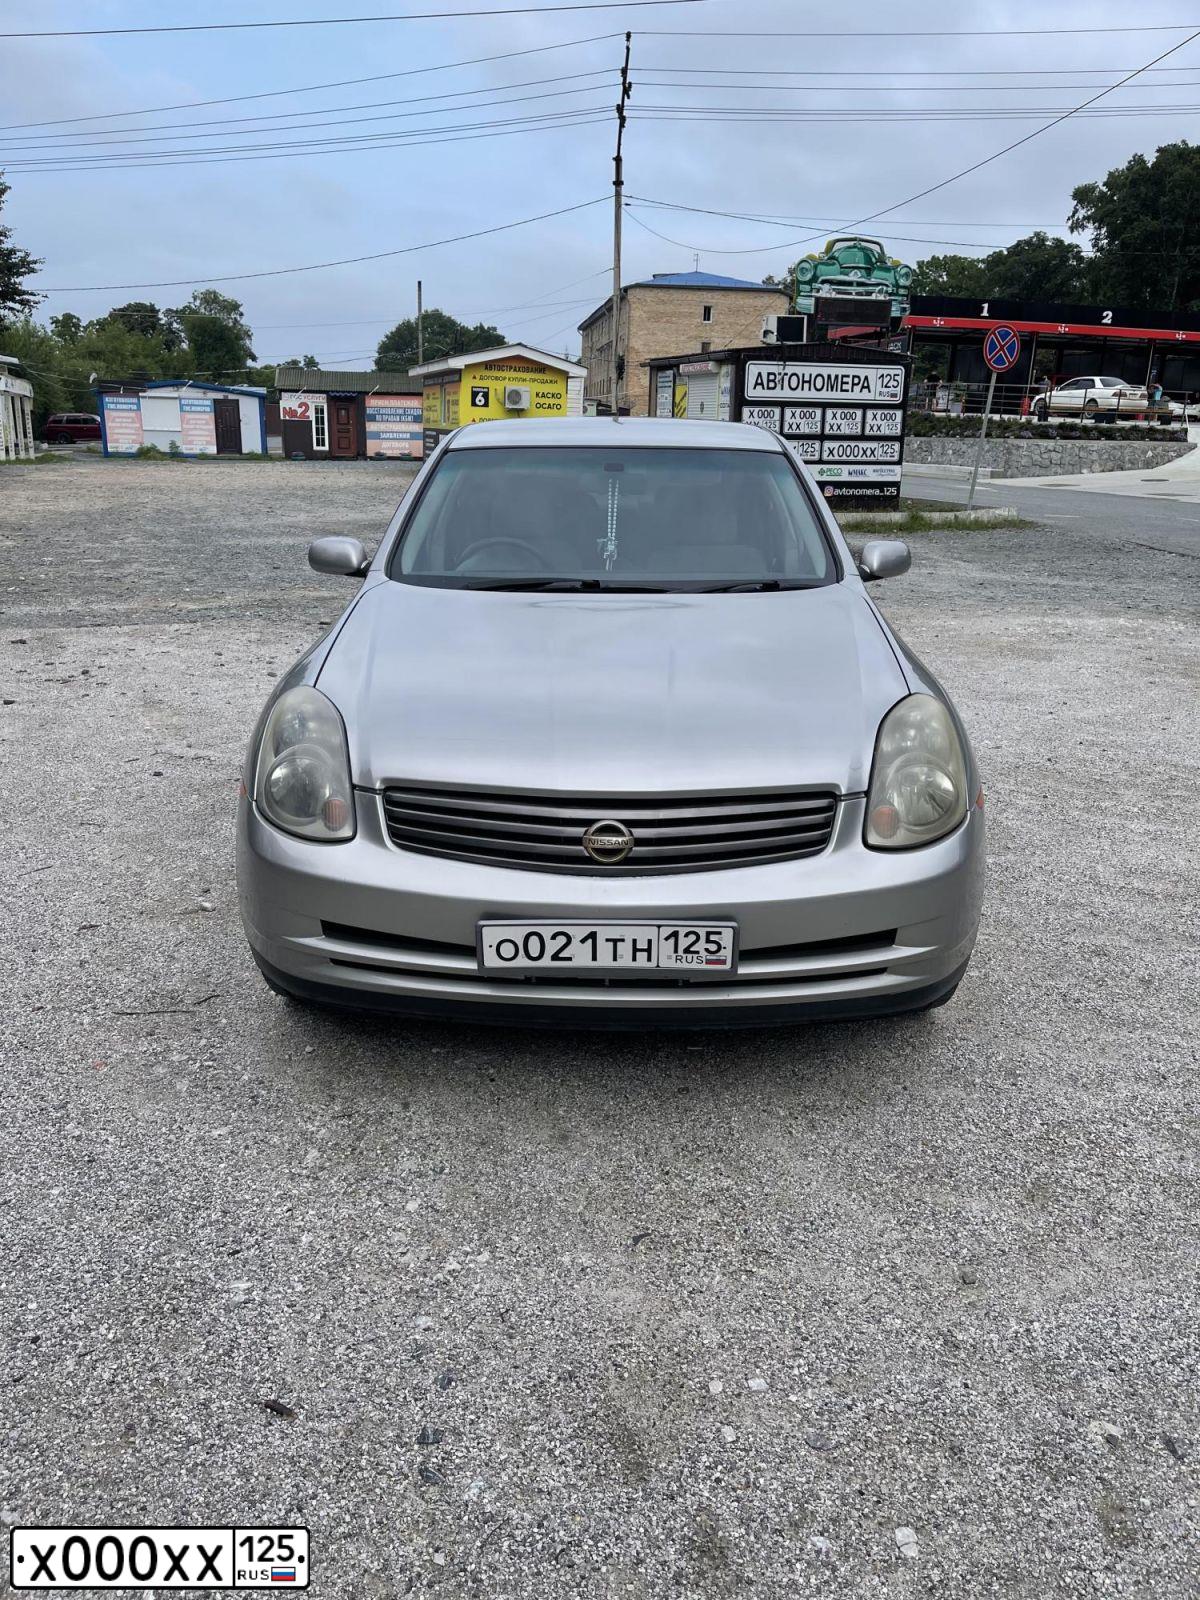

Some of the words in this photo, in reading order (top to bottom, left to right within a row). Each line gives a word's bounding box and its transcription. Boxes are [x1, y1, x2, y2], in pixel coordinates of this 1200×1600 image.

[980, 303, 989, 316] 1
[1101, 310, 1113, 324] 2
[484, 364, 546, 375] АВТОСТРАХОВАНИЕ
[753, 371, 872, 394] АВТОНОМЕРА
[878, 373, 900, 389] 125
[475, 392, 485, 406] 6
[535, 392, 562, 400] КАСКО
[535, 402, 562, 410] ОСАГО
[806, 422, 819, 430] 125
[847, 423, 859, 431] 125
[886, 423, 899, 431] 125
[799, 442, 816, 454] 125
[879, 443, 896, 454] 125
[834, 487, 897, 496] avtonomera_125
[588, 838, 629, 846] NISSAN
[663, 930, 723, 955] 125
[674, 955, 704, 964] RUS
